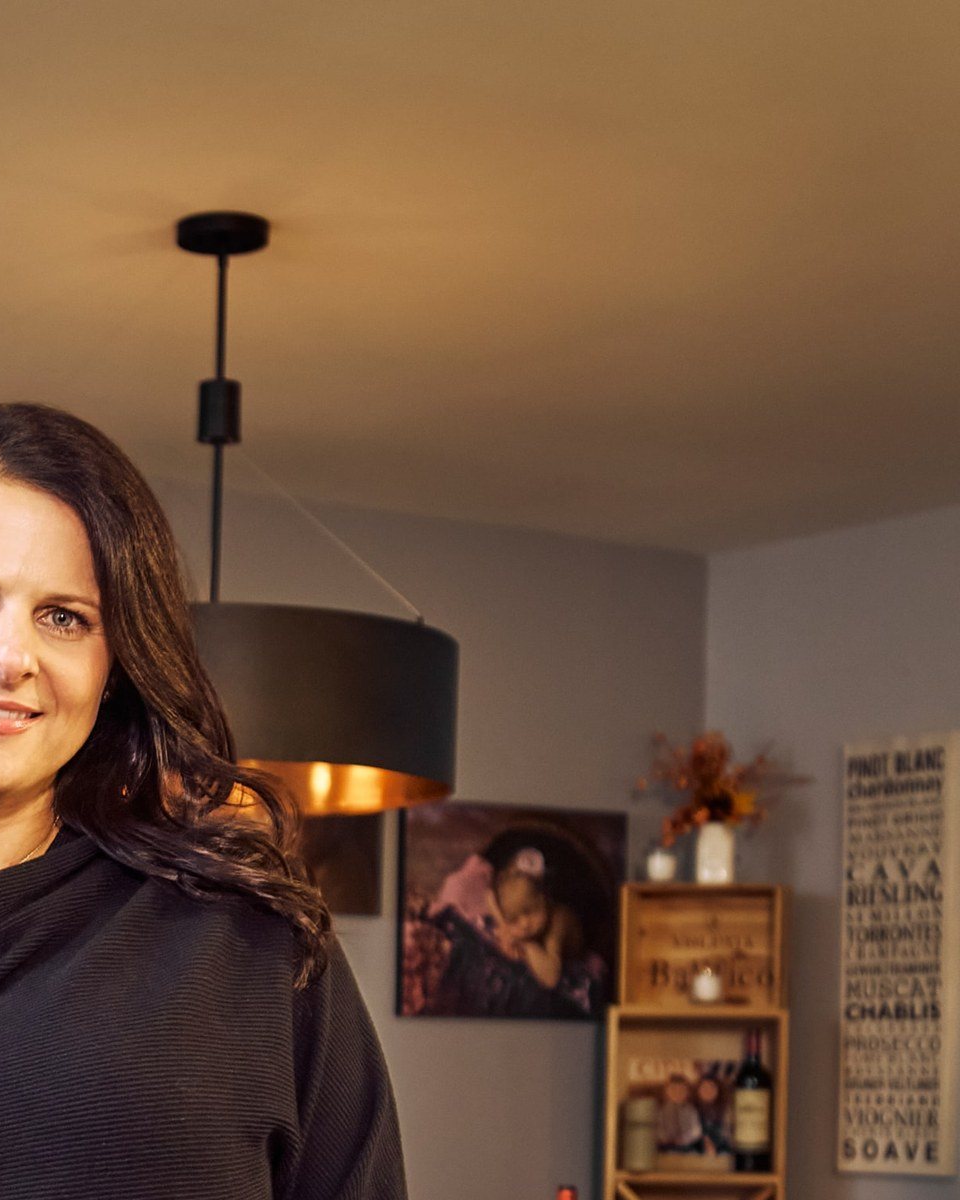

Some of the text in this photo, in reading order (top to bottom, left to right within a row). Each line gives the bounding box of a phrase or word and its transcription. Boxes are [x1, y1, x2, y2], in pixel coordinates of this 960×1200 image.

[848, 745, 945, 778] PINOT BLANC
[847, 776, 943, 799] chardonnay
[846, 858, 941, 883] CAVA
[846, 881, 943, 906] RIESLING
[845, 999, 941, 1021] CHABLIS
[843, 1137, 940, 1164] SOAVE
